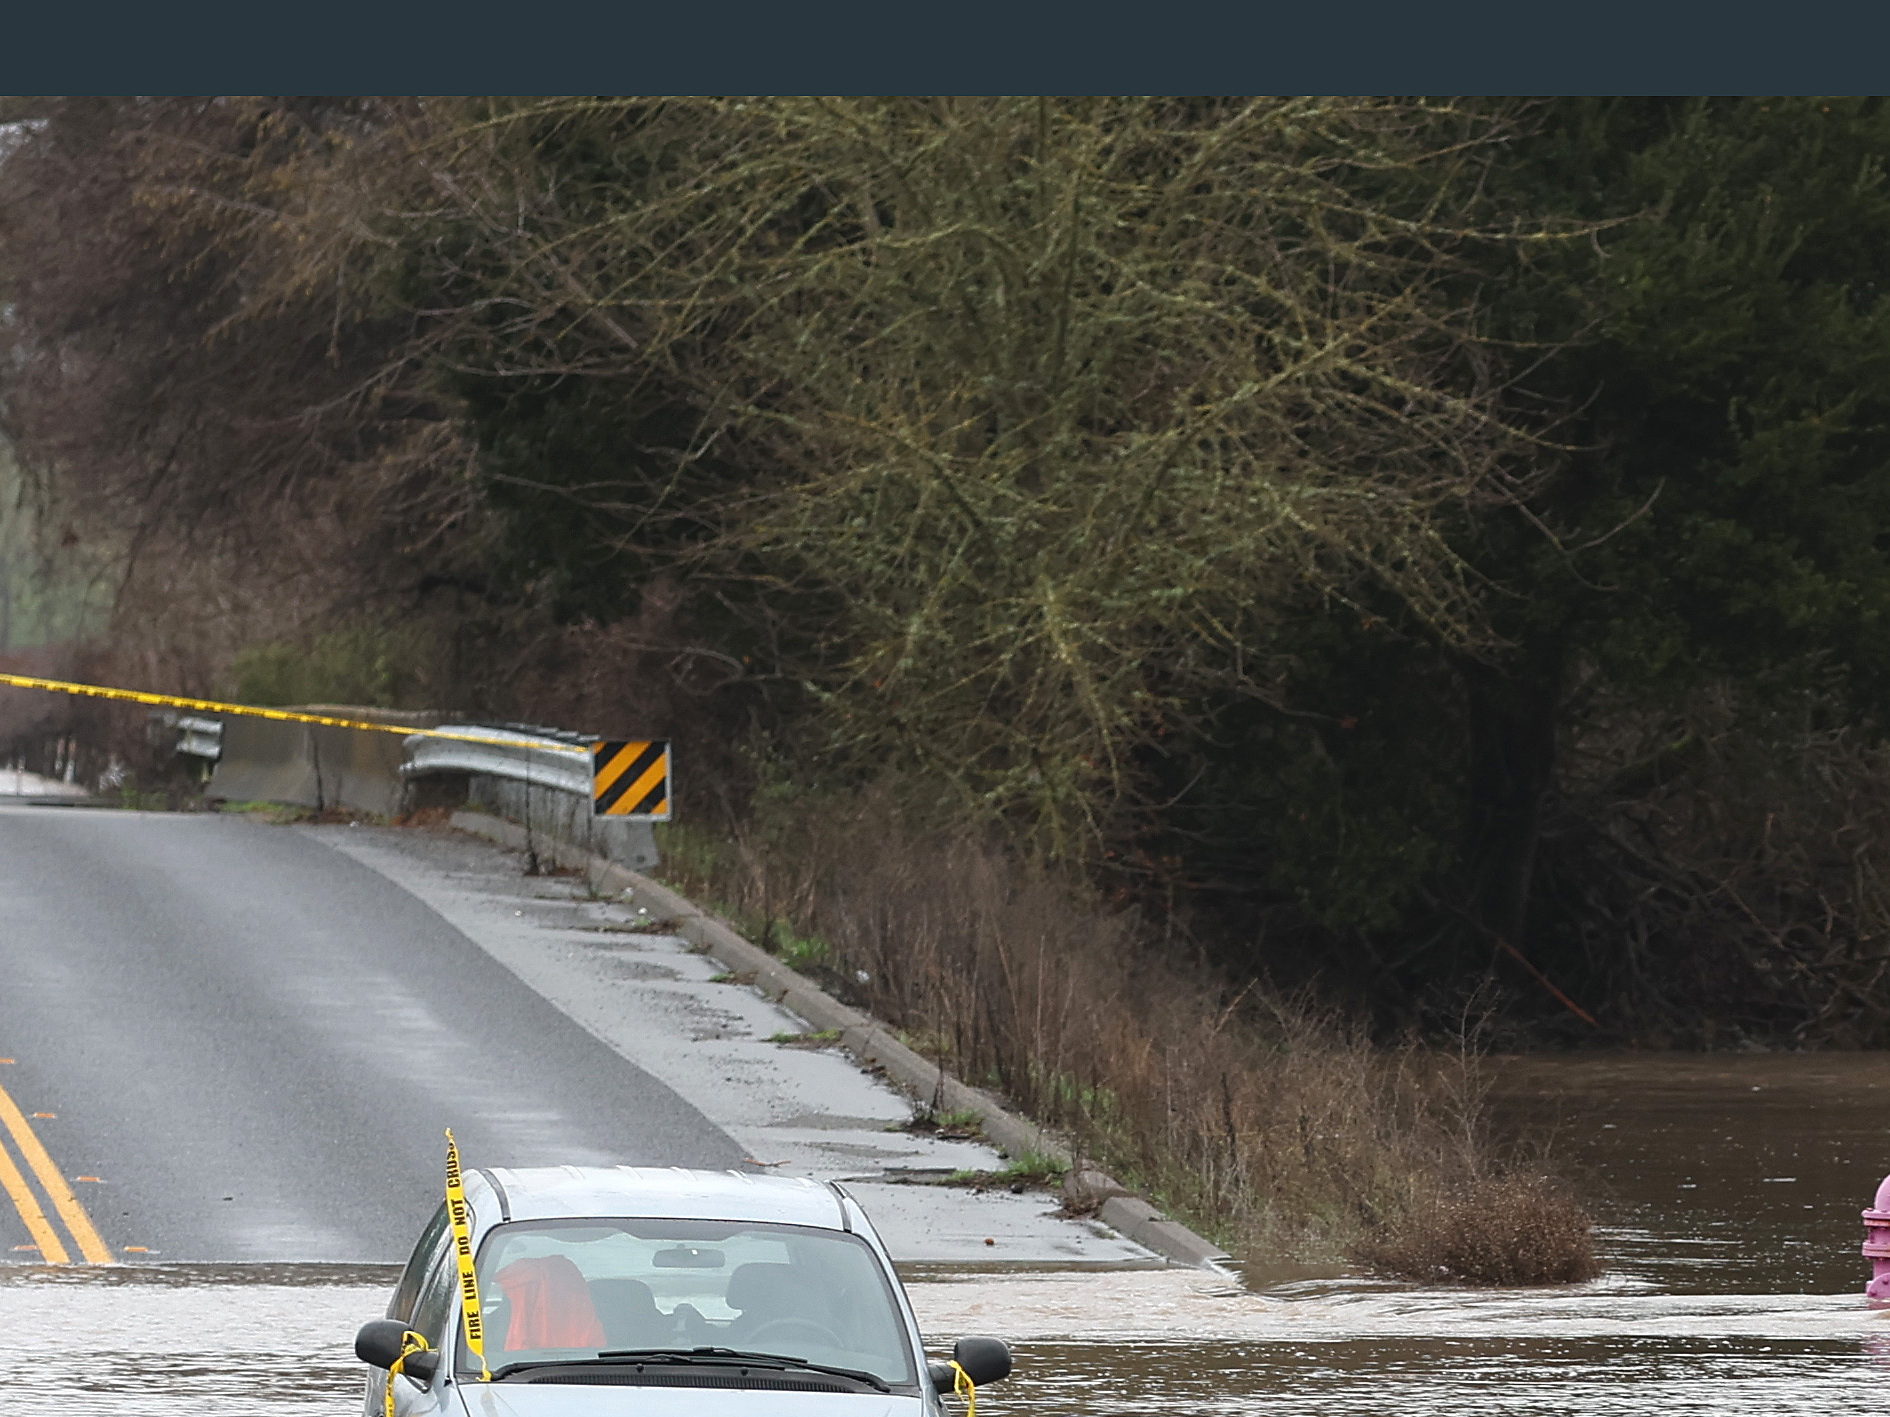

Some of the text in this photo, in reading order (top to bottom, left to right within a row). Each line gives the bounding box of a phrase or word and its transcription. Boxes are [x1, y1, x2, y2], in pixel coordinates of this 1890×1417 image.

[451, 1199, 467, 1227] NOT
[459, 1235, 471, 1256] DO
[463, 1270, 476, 1301] LINE
[467, 1310, 482, 1340] FIRE
